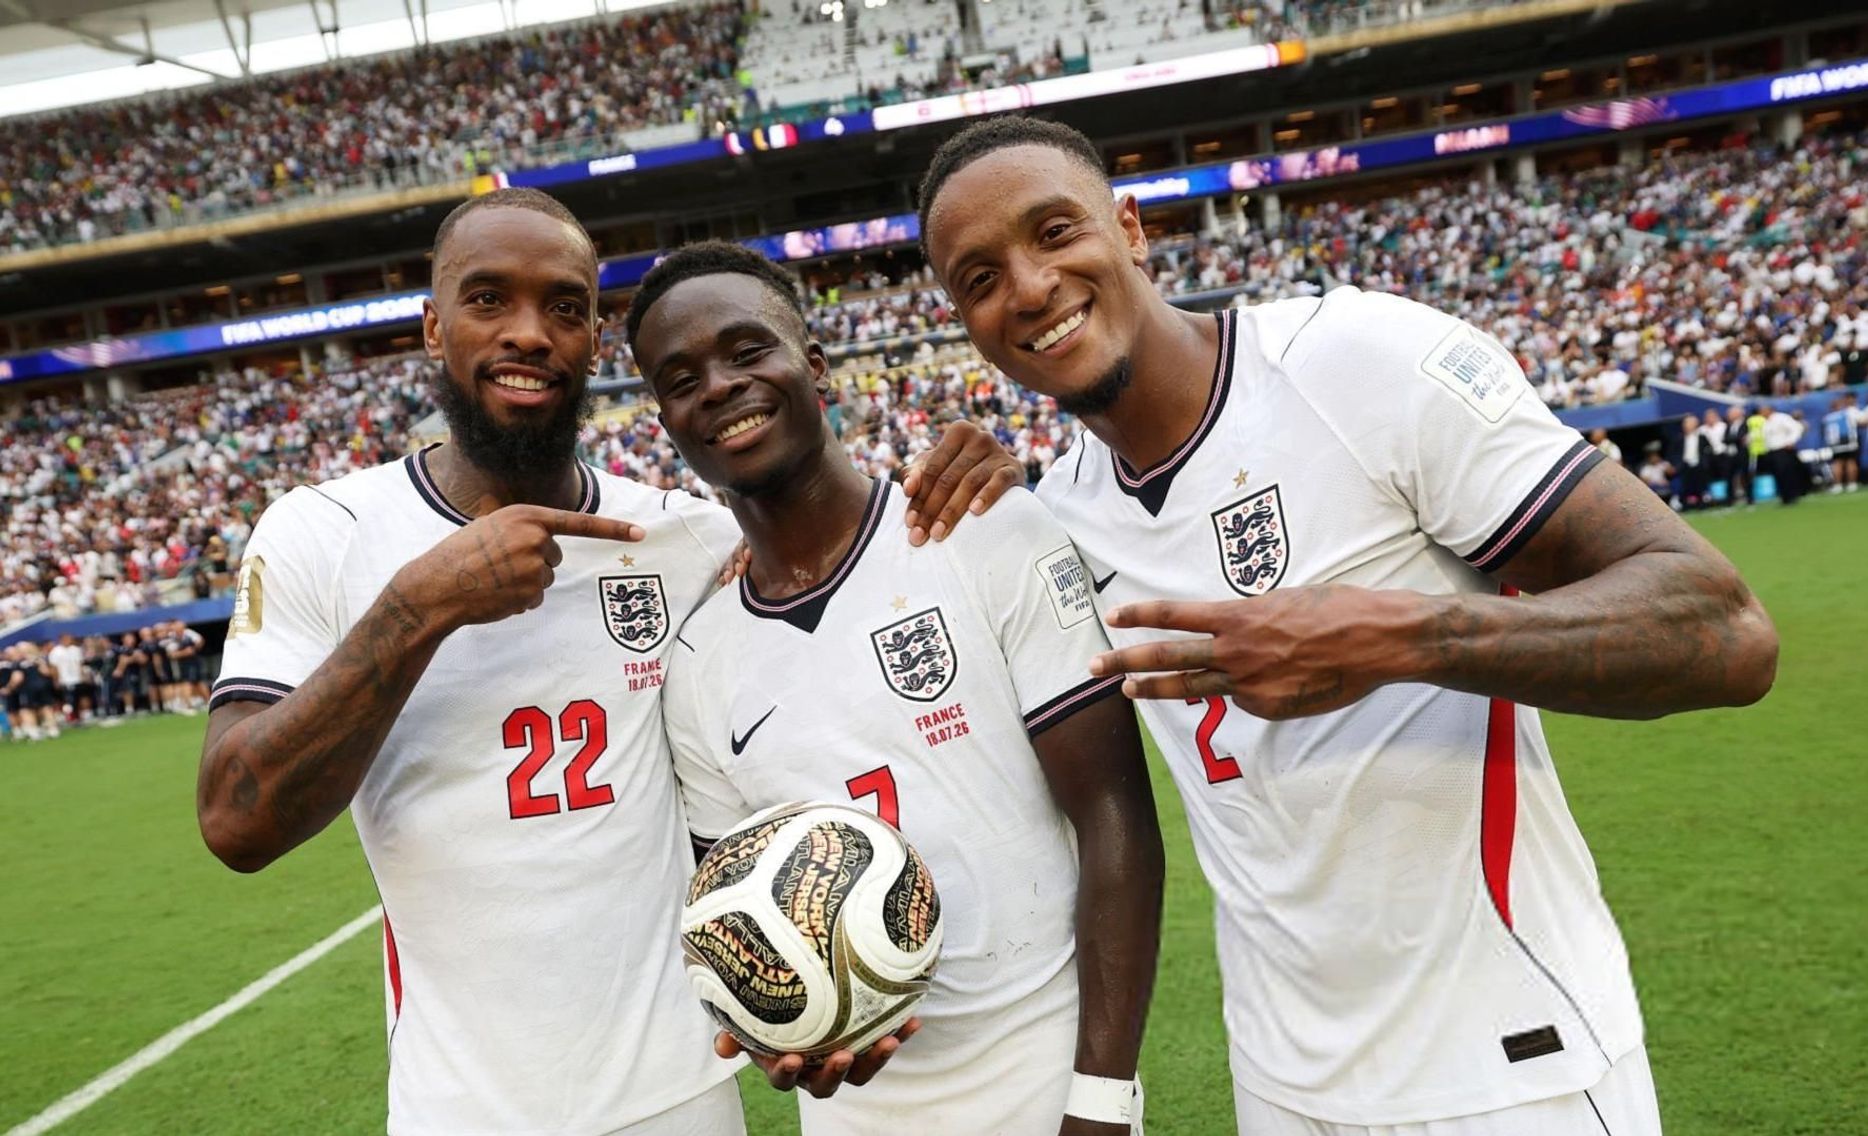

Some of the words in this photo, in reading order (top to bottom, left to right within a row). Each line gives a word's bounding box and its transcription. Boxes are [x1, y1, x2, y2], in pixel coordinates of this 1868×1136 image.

[915, 702, 965, 732] FRANCE
[926, 721, 969, 748] 18.07.26
[502, 699, 615, 820] 22
[845, 764, 901, 832] 7
[779, 836, 812, 917] TLANT
[823, 830, 844, 871] NEW
[826, 831, 860, 926] MIAM
[793, 862, 820, 935] JERSEY
[809, 873, 836, 937] YORK
[908, 888, 921, 942] NEW
[918, 901, 930, 944] NEW
[698, 937, 751, 979] JERSEY
[704, 920, 797, 984] ATLANTA
[723, 912, 791, 969] DALLA
[750, 975, 792, 999] NEW
